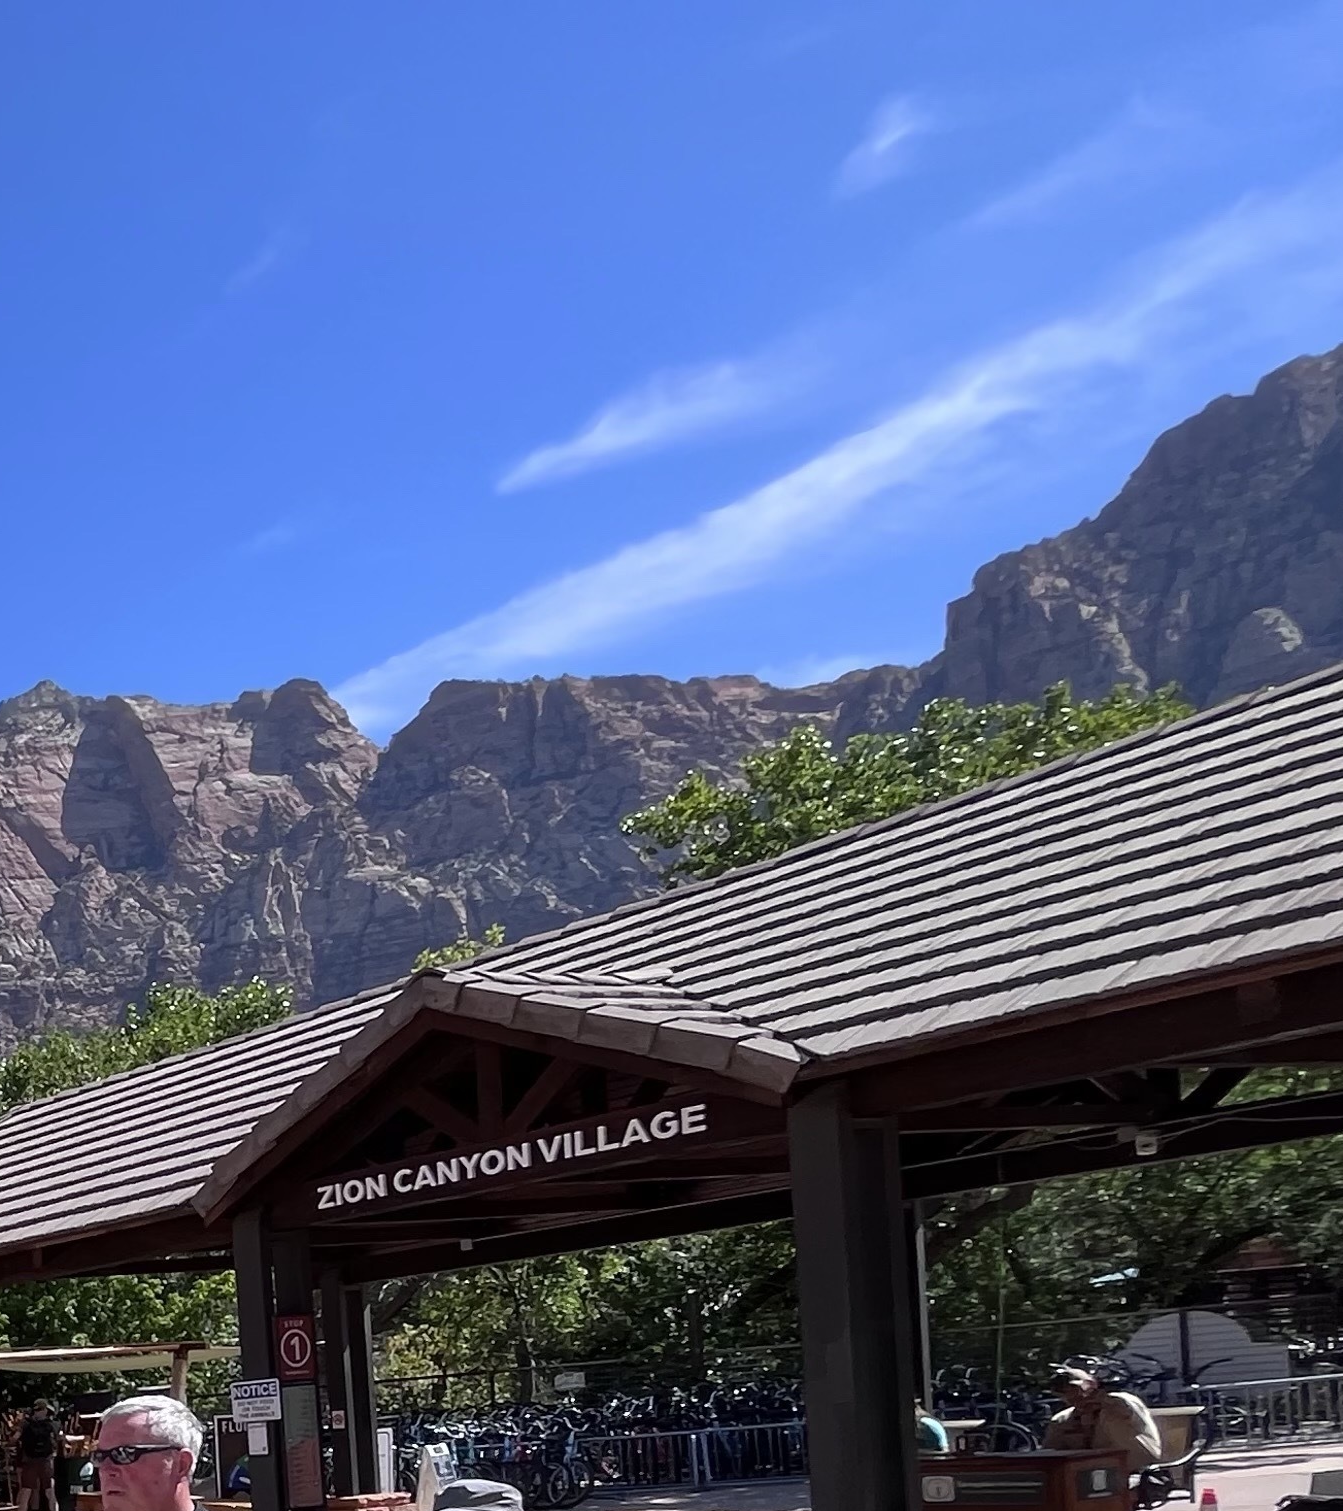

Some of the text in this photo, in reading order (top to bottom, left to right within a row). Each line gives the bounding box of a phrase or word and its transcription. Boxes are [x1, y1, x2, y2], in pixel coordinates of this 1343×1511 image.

[316, 1103, 708, 1210] ZION CANYON VILLAGE
[290, 1336, 301, 1361] 1
[232, 1382, 277, 1398] NOTICE
